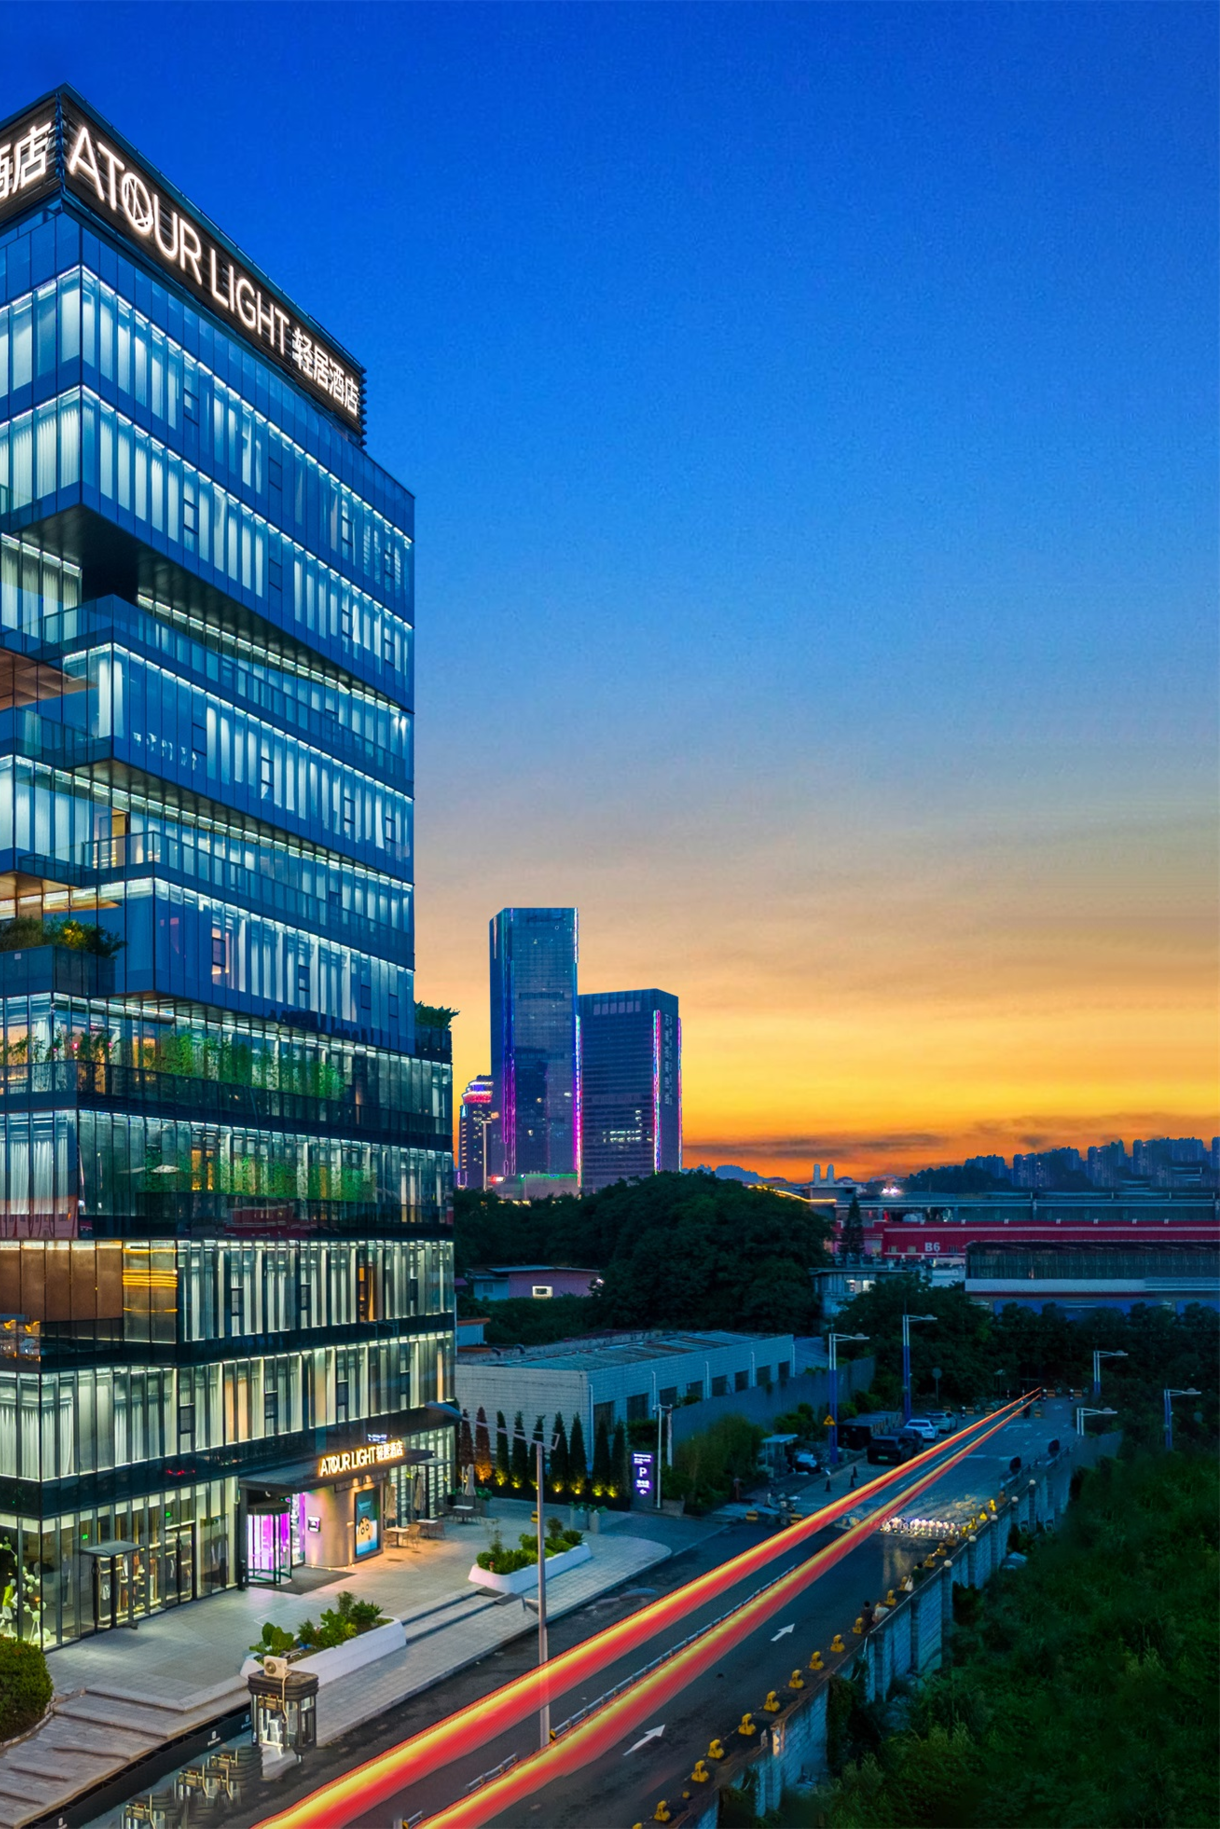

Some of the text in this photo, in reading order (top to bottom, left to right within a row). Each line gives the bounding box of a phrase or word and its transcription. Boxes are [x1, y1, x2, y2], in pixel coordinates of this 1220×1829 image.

[67, 126, 359, 416] ATOUR LIGHT 轻居酒店
[924, 1242, 941, 1252] B6
[320, 1453, 351, 1477] ATOUR
[351, 1446, 376, 1469] LIGHT
[639, 1467, 648, 1477] P
